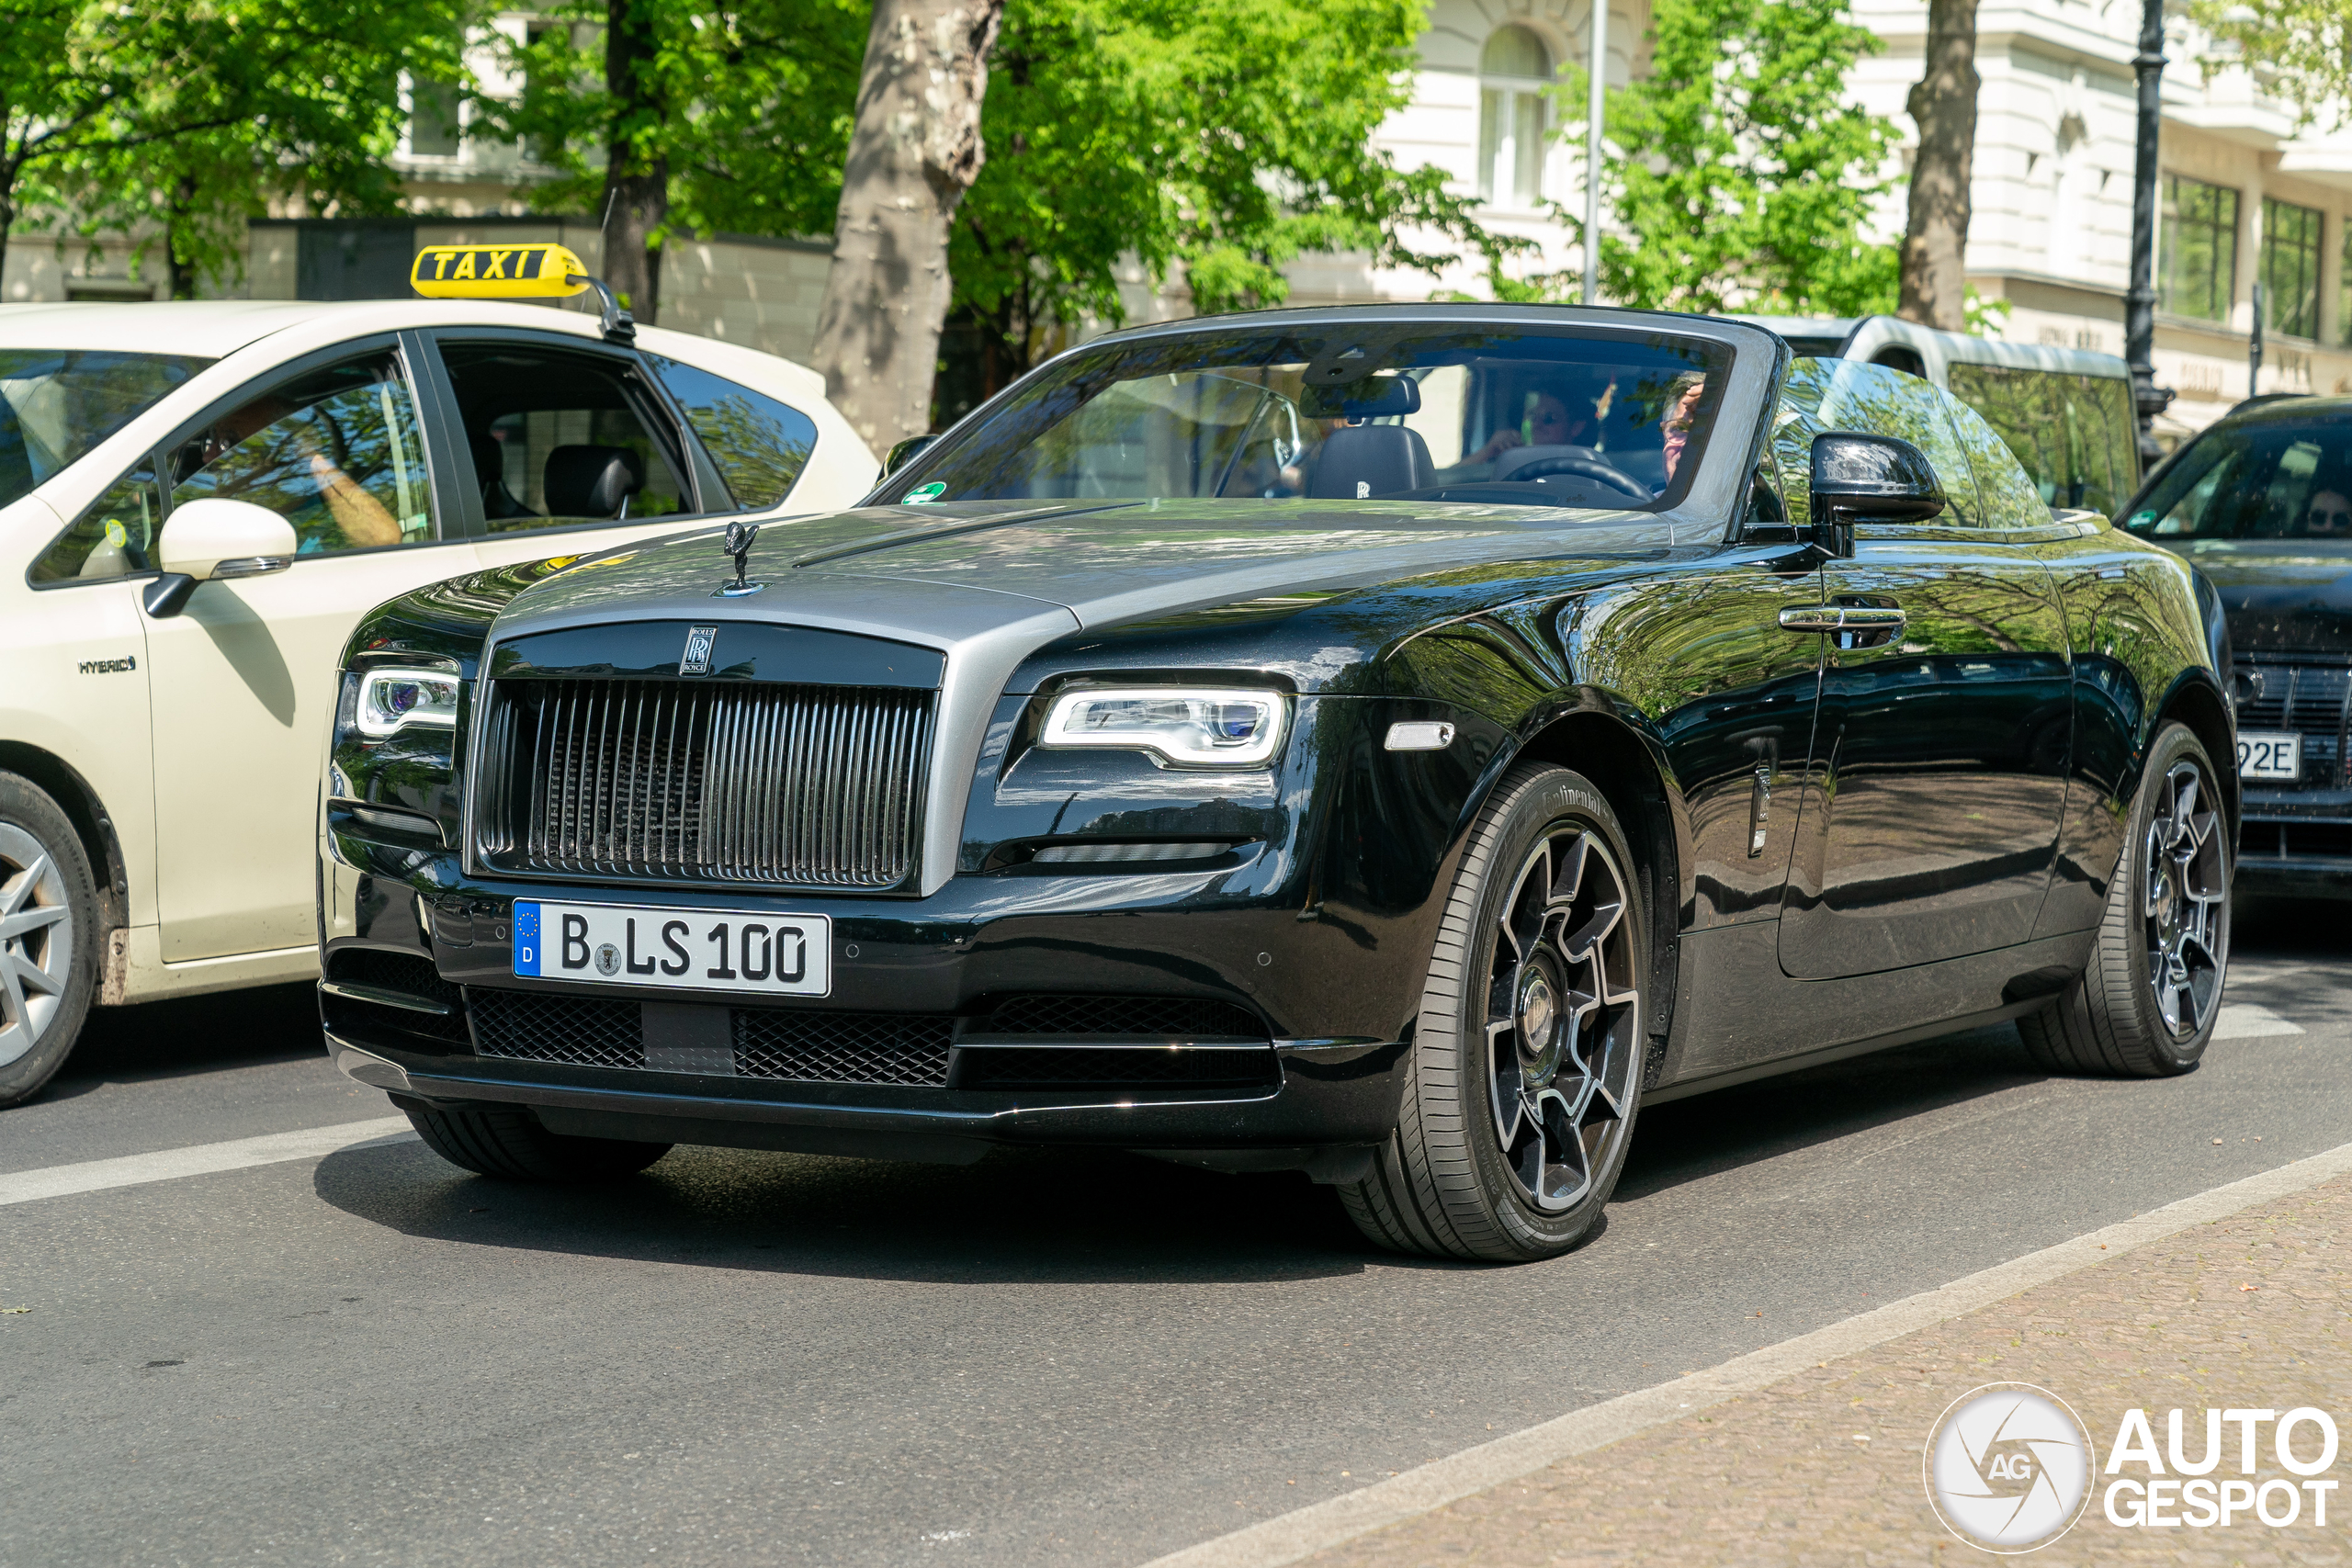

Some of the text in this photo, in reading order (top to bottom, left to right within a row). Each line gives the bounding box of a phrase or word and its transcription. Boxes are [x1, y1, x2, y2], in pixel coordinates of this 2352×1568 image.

[434, 251, 530, 279] TAXI
[77, 656, 136, 674] HYBRID
[1543, 784, 1600, 818] Continental
[522, 946, 533, 963] D
[562, 913, 591, 969] B
[627, 917, 691, 976] LS
[707, 922, 807, 982] 100
